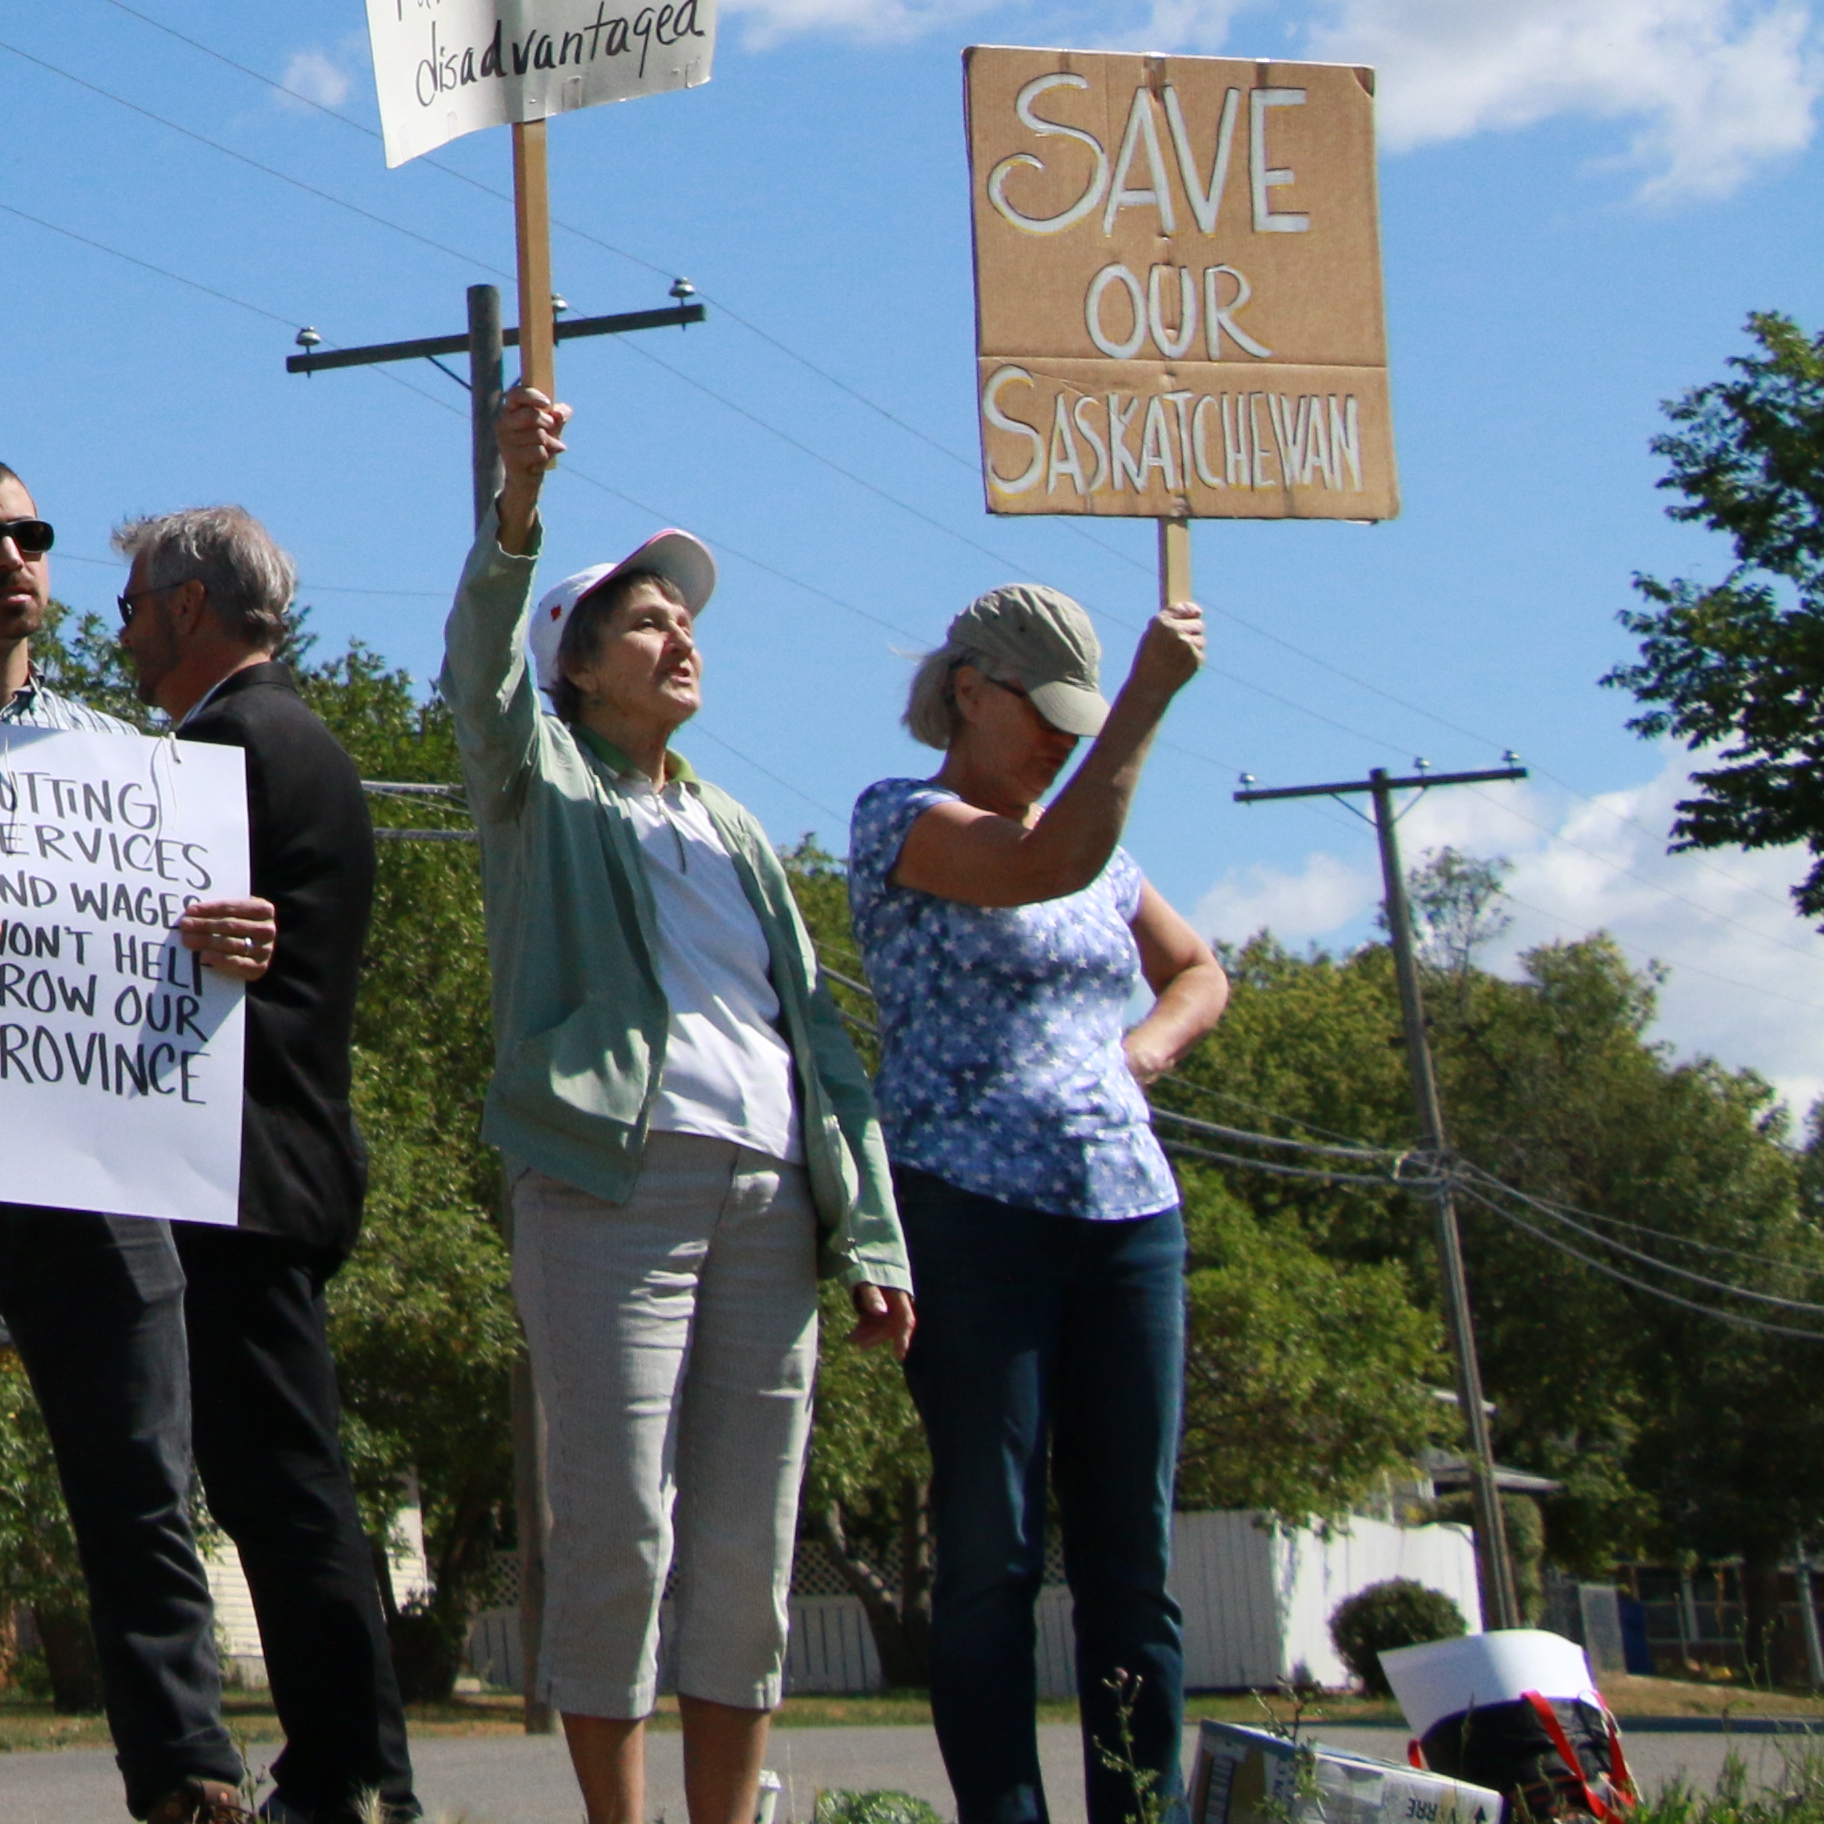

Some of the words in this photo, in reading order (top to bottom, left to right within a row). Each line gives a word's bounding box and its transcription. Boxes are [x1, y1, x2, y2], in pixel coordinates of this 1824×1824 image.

[988, 71, 1311, 238] SAVE
[1084, 261, 1274, 361] OUR
[983, 363, 1363, 500] SASKATCHEWAN
[114, 984, 209, 1043] OUR
